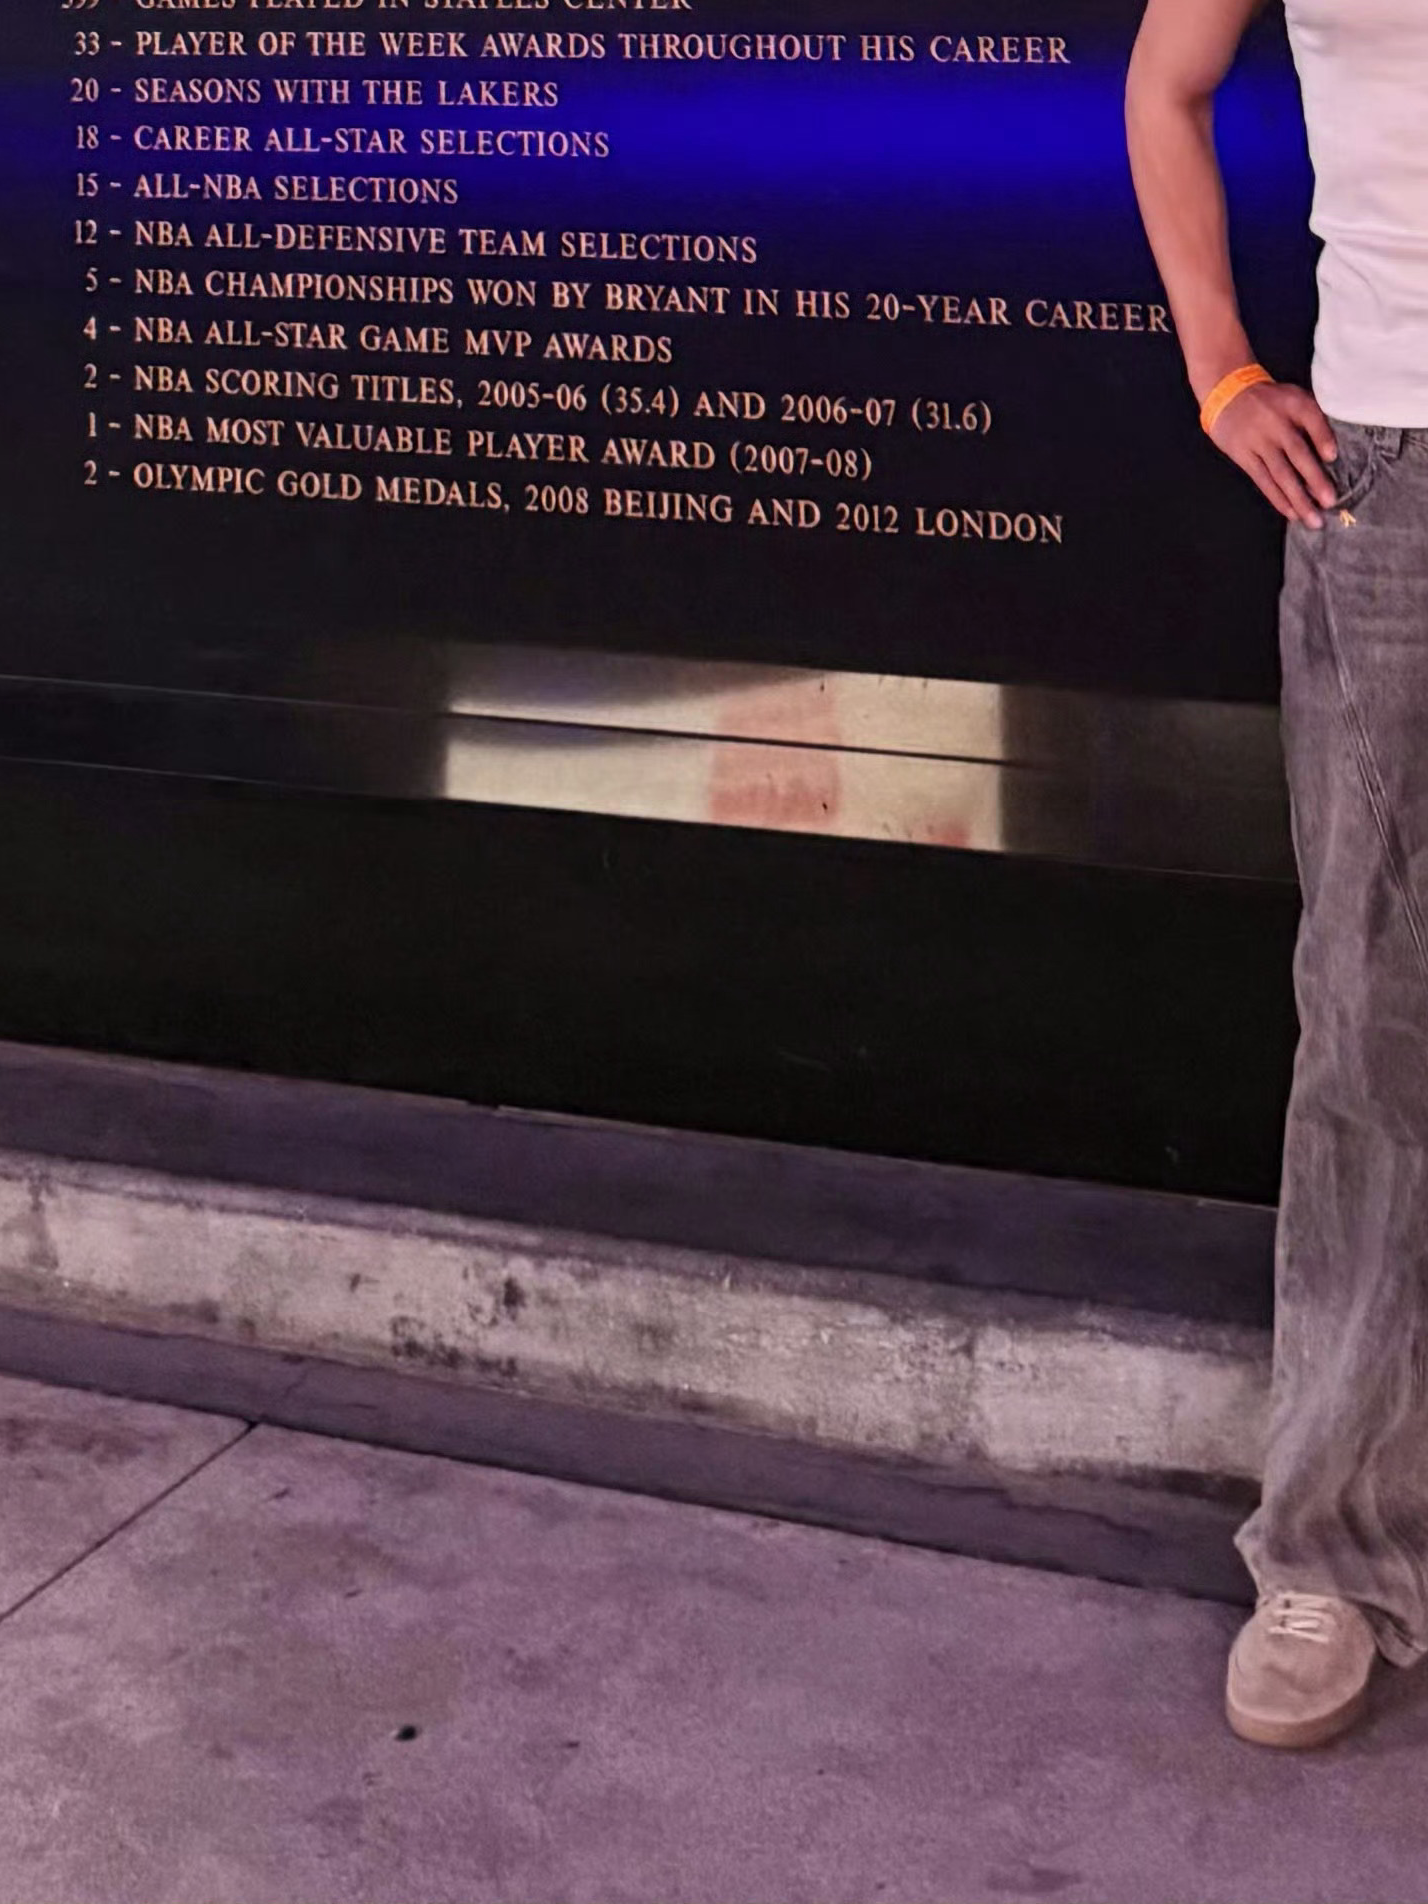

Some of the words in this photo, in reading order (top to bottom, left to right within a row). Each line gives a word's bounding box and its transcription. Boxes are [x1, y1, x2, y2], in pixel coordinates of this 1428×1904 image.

[73, 30, 101, 57] 33
[135, 30, 248, 56] PLAYER
[257, 31, 297, 57] OF
[305, 31, 367, 57] THE
[378, 31, 469, 58] WEEK
[479, 31, 606, 60] AWARDS
[616, 32, 847, 61] THROUGHOUT
[859, 34, 915, 62] HIS
[929, 35, 1072, 65] CAREER
[70, 77, 100, 103] 20
[134, 77, 262, 104] SEASONS
[273, 78, 351, 105] WITH
[361, 79, 424, 106] THE
[437, 79, 559, 108] LAKERS
[76, 124, 100, 150] 18
[133, 124, 253, 152] CAREER
[263, 126, 408, 154] ALL-STAR
[420, 128, 610, 158] SELECTIONS
[76, 172, 99, 198] 15
[132, 172, 263, 201] ALL-NBA
[273, 174, 459, 205] SELECTIONS
[75, 218, 98, 245] 12
[134, 219, 194, 248] NBA
[203, 222, 447, 255] ALL-DEFENSIVE
[457, 227, 547, 257] TEAM
[561, 231, 758, 264] SELECTIONS
[85, 266, 99, 293] 5
[134, 267, 195, 296] NBA
[204, 269, 454, 305] CHAMPIONSHIPS
[466, 277, 537, 307] WON
[551, 280, 592, 309] BY
[605, 282, 731, 315] BRYANT
[743, 287, 780, 316] IN
[795, 289, 851, 320] HIS
[865, 292, 1012, 326] 20-YEAR
[1024, 298, 1171, 333] CAREER
[82, 315, 98, 341] 4
[134, 315, 194, 344] NBA
[203, 319, 349, 351] ALL-STAR
[359, 324, 450, 354] GAME
[464, 328, 533, 358] MVP
[542, 331, 673, 364] AWARDS
[83, 362, 98, 389] 2
[134, 364, 194, 394] NBA
[205, 367, 340, 400] SCORING
[350, 374, 463, 409] TITLES,
[477, 379, 588, 412] 2005-06
[600, 383, 680, 418] (35.4)
[692, 390, 766, 420] AND
[780, 393, 896, 427] 2006-07
[911, 397, 992, 435] (31.6)
[88, 411, 98, 438] 1
[133, 413, 194, 442] NBA
[206, 415, 285, 447] MOST
[295, 420, 453, 456] VALUABLE
[467, 429, 590, 464] PLAYER
[600, 437, 716, 470] AWARD
[729, 440, 873, 481] (2007-08)
[83, 459, 98, 486] 2
[133, 462, 266, 495] OLYMPIC
[276, 469, 363, 501] GOLD
[375, 475, 510, 513] MEDALS,
[524, 483, 589, 515] 2008
[603, 487, 734, 523] BEIJING
[747, 498, 821, 529] AND
[835, 501, 899, 534] 2012
[915, 506, 1063, 544] LONDON
